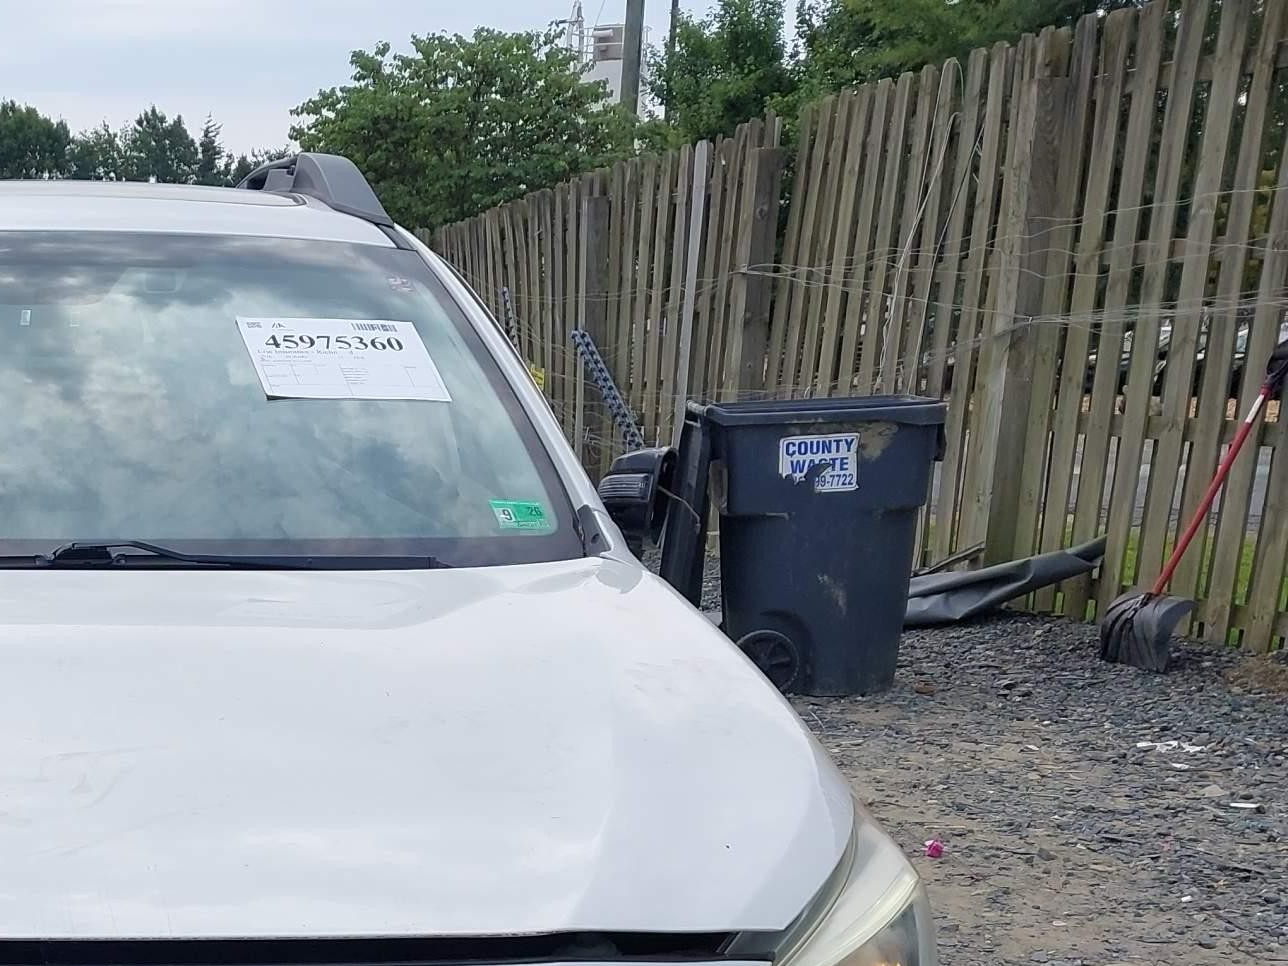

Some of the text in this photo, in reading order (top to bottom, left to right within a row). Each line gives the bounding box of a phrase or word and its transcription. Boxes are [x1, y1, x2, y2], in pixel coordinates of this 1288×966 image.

[265, 334, 404, 351] 45975360
[785, 438, 855, 456] COUNTY
[502, 509, 513, 521] 9
